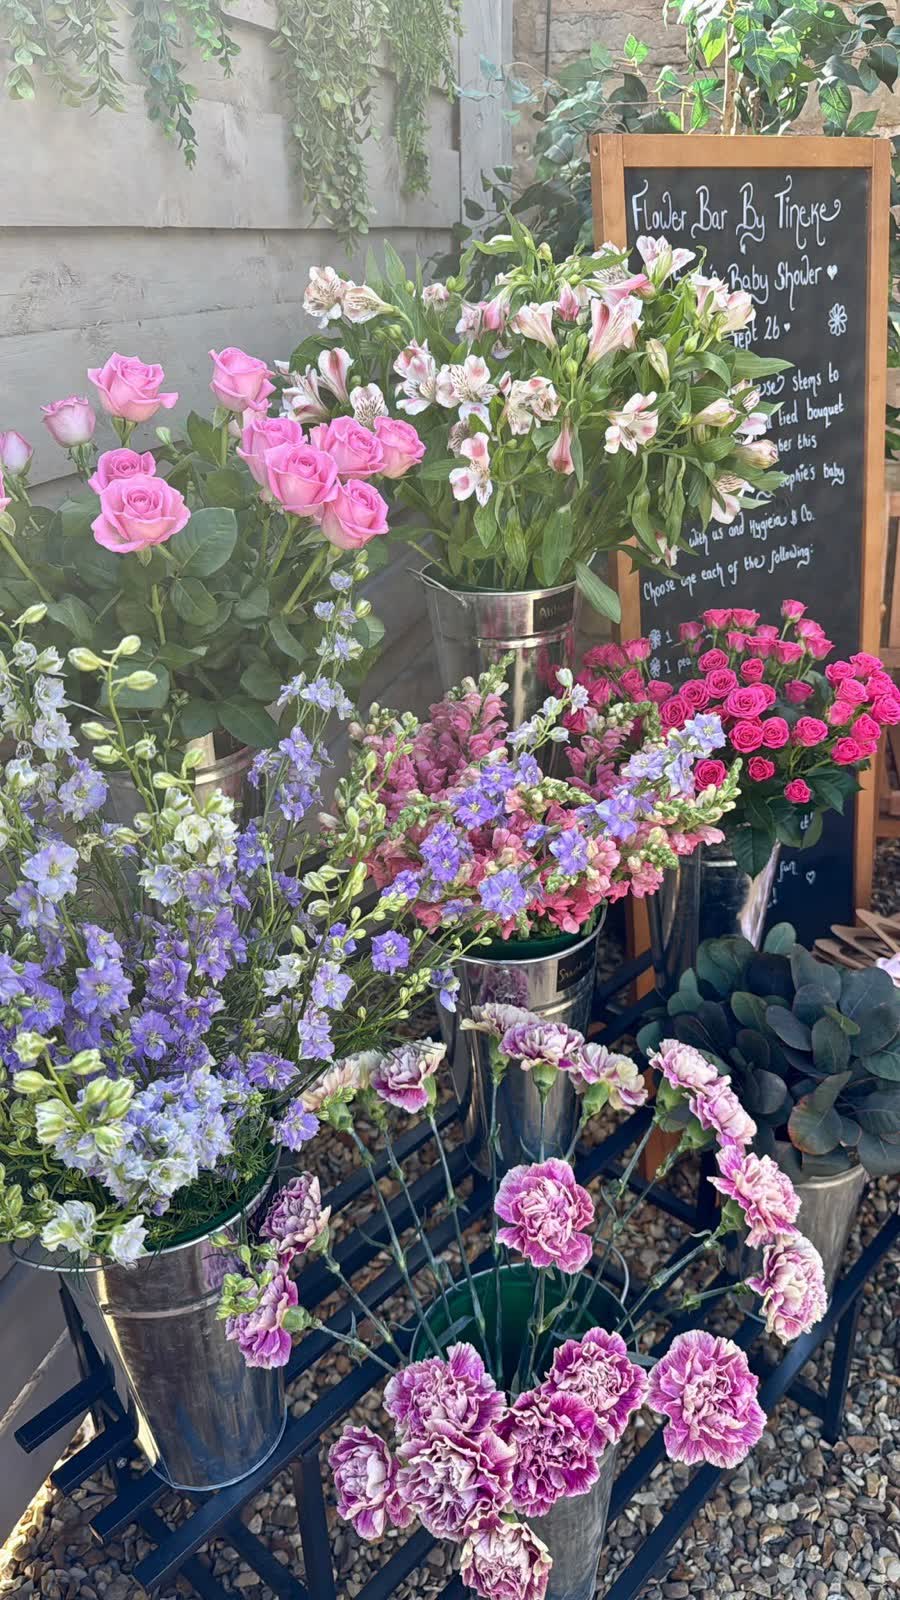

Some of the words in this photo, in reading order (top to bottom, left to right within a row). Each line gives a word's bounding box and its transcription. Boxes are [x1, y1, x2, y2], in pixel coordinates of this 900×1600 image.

[632, 179, 687, 231] Flower
[691, 185, 728, 239] Bar
[736, 182, 766, 255] By
[774, 175, 842, 250] Tineke
[727, 262, 770, 305] Baby
[774, 255, 823, 312] Shower
[763, 315, 781, 340] 26
[792, 369, 822, 397] stems
[828, 361, 841, 383] to
[778, 399, 799, 427] tied
[806, 392, 845, 429] bouquet
[797, 433, 818, 449] this
[823, 461, 846, 486] baby
[688, 528, 710, 556] with
[711, 527, 724, 541] us
[728, 511, 745, 537] and
[643, 581, 676, 607] Choose
[701, 562, 726, 588] each
[727, 560, 739, 585] of
[743, 554, 766, 571] the
[767, 543, 814, 574] following:
